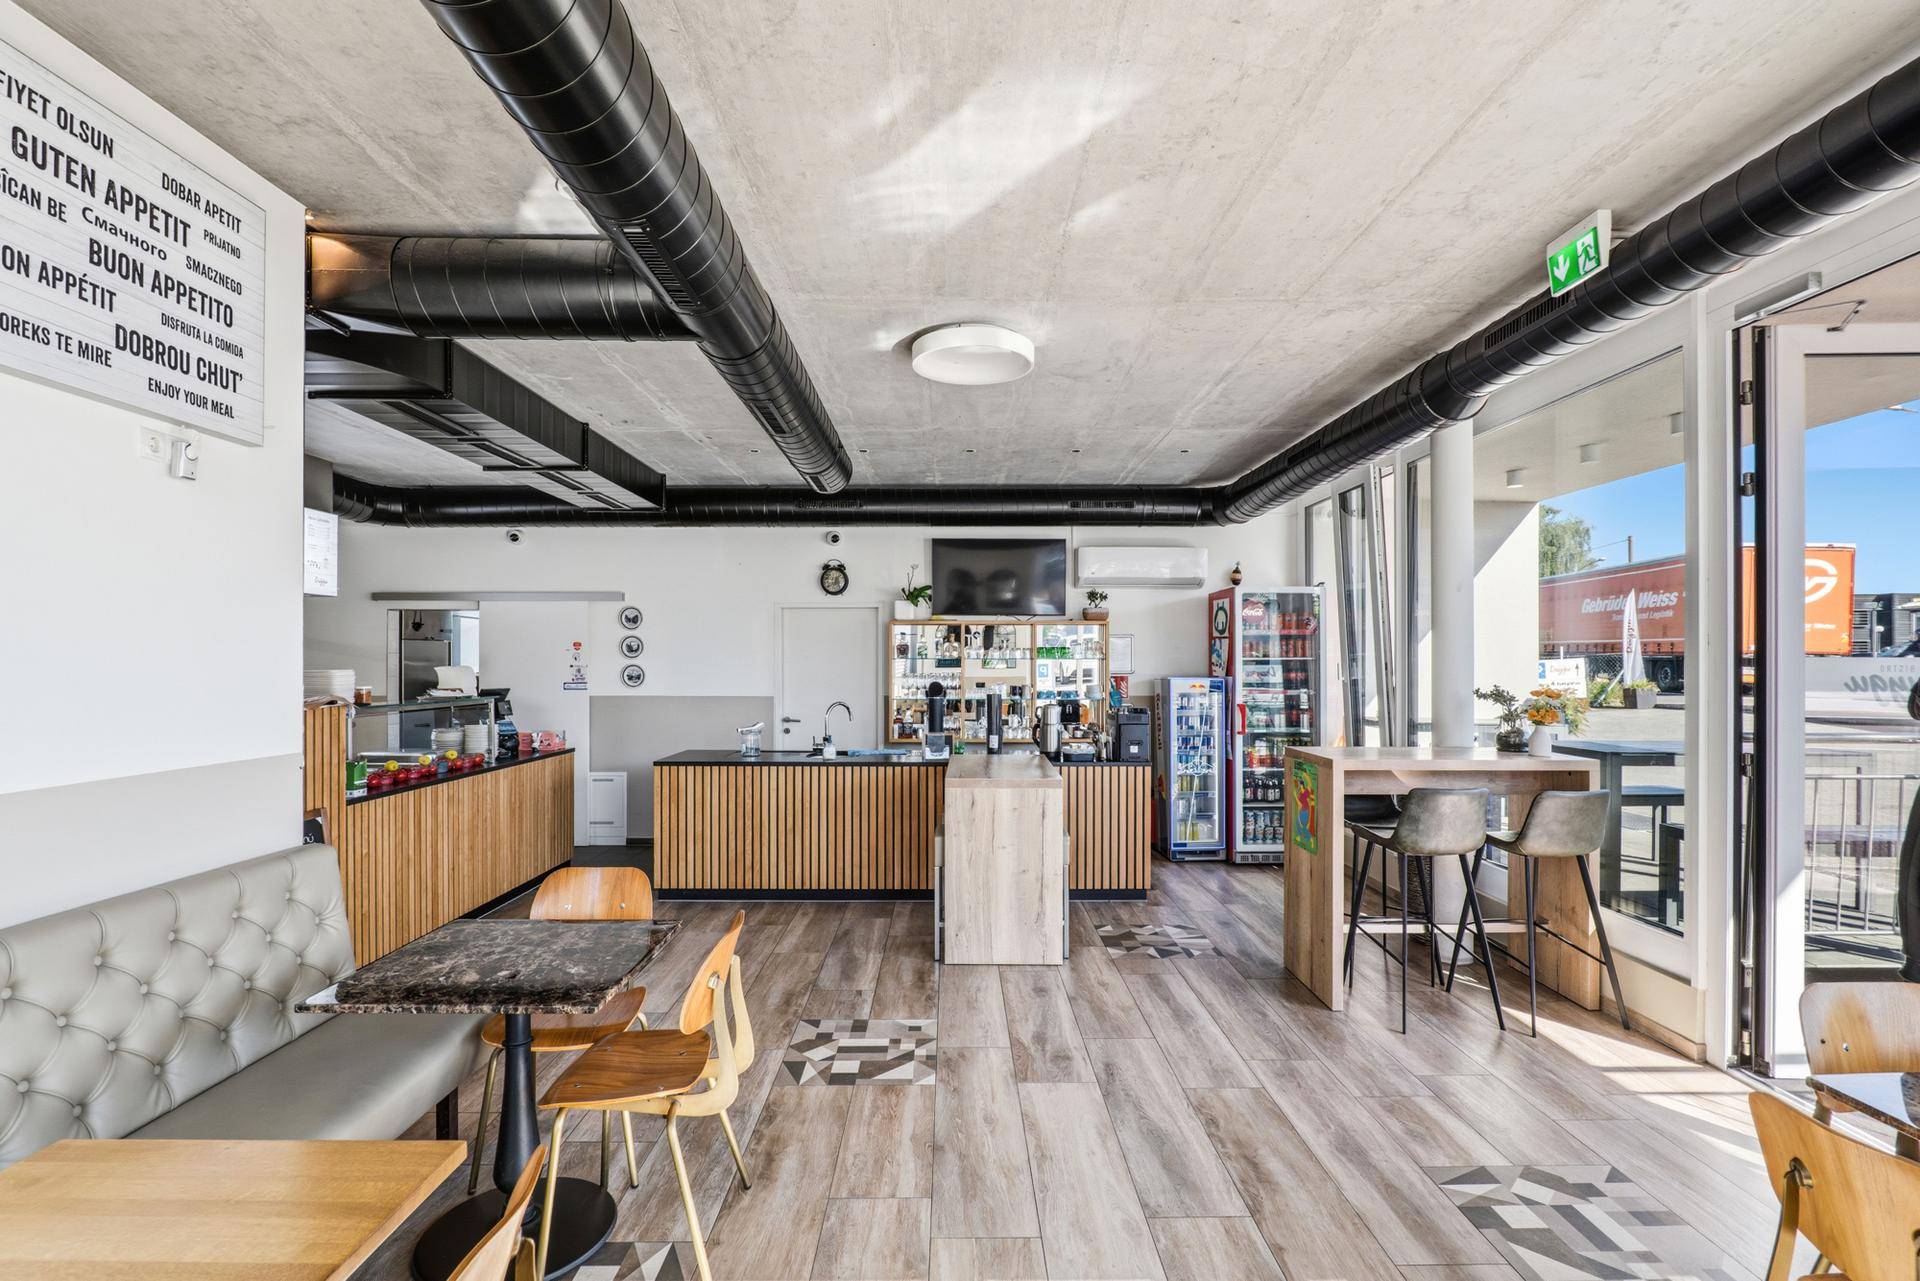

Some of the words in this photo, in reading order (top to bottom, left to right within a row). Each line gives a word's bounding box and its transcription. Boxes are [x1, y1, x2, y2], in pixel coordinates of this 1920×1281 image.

[57, 106, 114, 159] OLSUN
[0, 168, 41, 210] ÎCAN
[47, 196, 67, 223] BE
[11, 126, 96, 198] GUTEN
[104, 179, 191, 248] APPETIT
[161, 172, 201, 210] DOBAR
[204, 199, 242, 234] APETIT
[82, 207, 167, 261] Смачного
[203, 229, 242, 259] PRIJATNO
[1, 244, 30, 279] ON
[38, 261, 117, 313] APPÉTIT
[88, 237, 144, 288] BUON
[151, 269, 233, 328] APPETITO
[185, 255, 242, 296] SMACZNEGO
[0, 311, 51, 346] OREKS
[55, 331, 73, 354] TE
[78, 340, 112, 368] MIRE
[115, 323, 190, 375] DOBROU
[161, 312, 201, 341] DISFRUTA
[203, 331, 213, 347] LA
[215, 336, 244, 359] COMIDA
[148, 377, 181, 400] ENJOY
[183, 389, 208, 410] YOUR
[211, 399, 235, 419] MEAL
[1582, 596, 1627, 613] Gebrüde
[1638, 591, 1679, 608] Weiss
